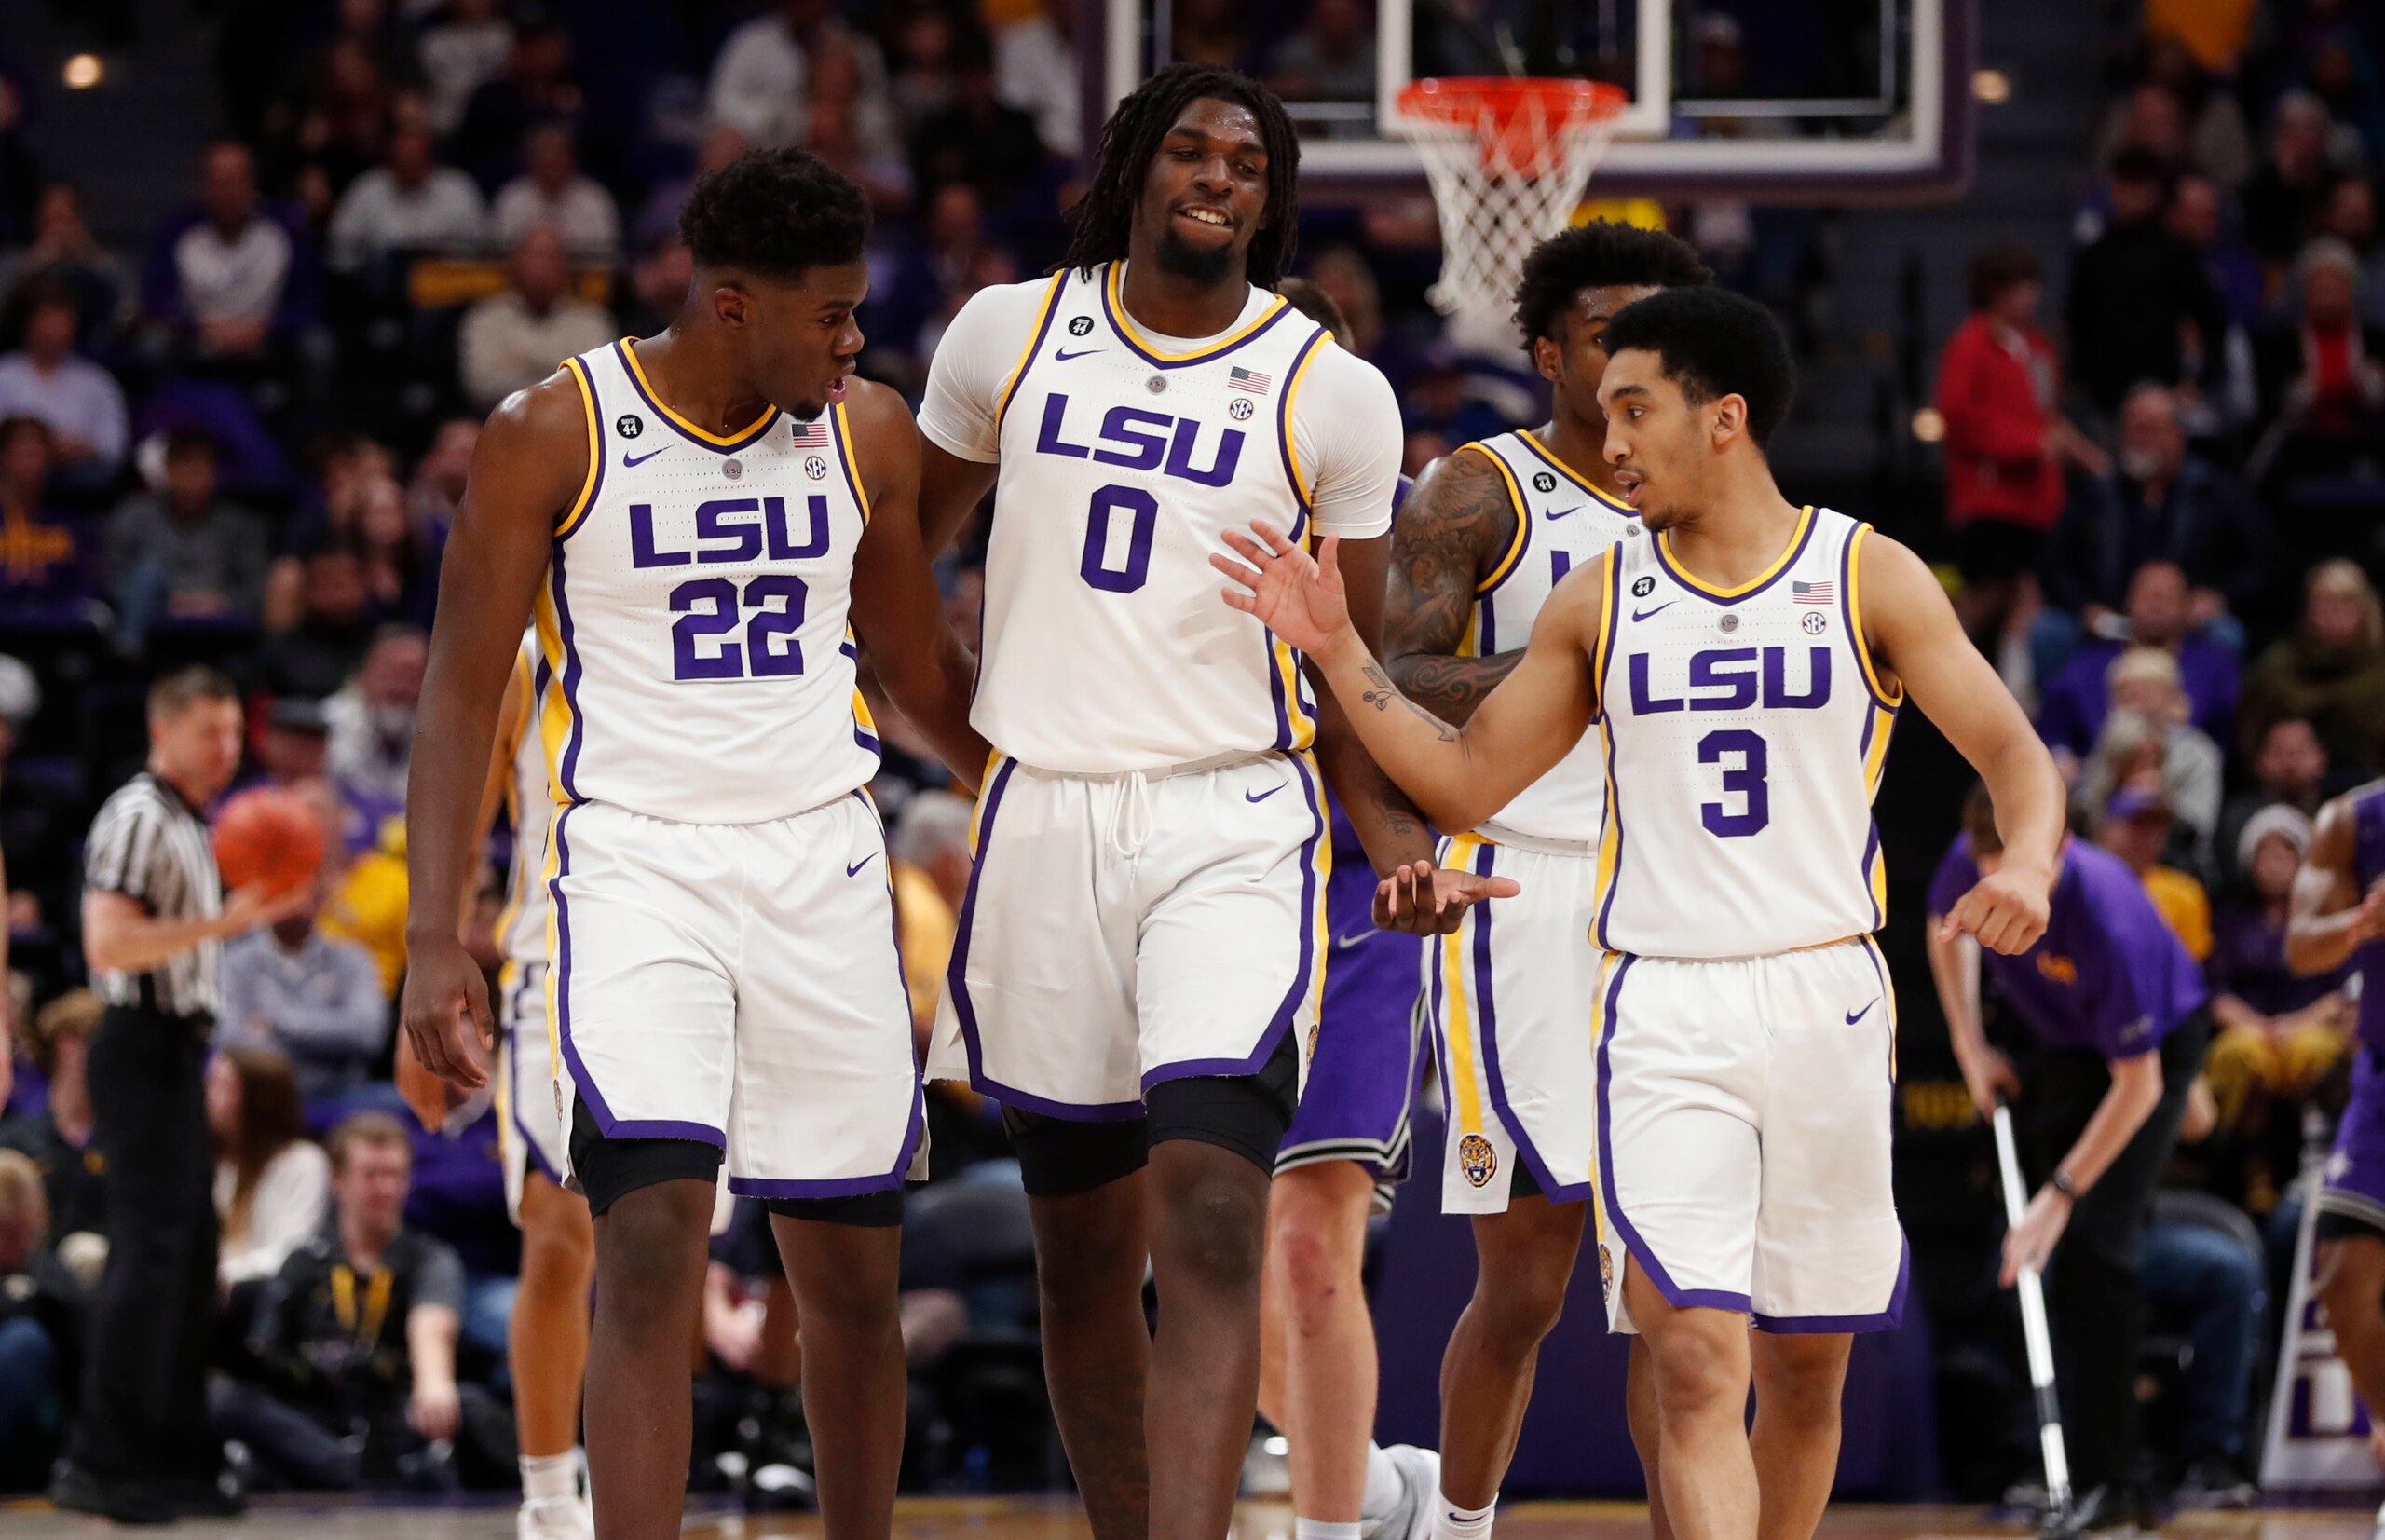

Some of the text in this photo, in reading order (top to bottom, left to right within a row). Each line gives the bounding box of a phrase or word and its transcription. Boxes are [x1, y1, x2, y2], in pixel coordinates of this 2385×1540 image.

[1073, 323, 1087, 334] 44
[1231, 399, 1253, 419] SEC
[622, 424, 637, 435] 44
[1036, 392, 1246, 487] LSU
[805, 457, 826, 479] SEC
[1539, 478, 1553, 490] 44
[629, 495, 830, 569] LSU
[1080, 484, 1159, 594] 0
[1637, 583, 1649, 594] 44
[669, 574, 809, 681] 22
[1804, 613, 1825, 634] SEC
[1629, 646, 1833, 716] LSU
[1697, 729, 1769, 838] 3
